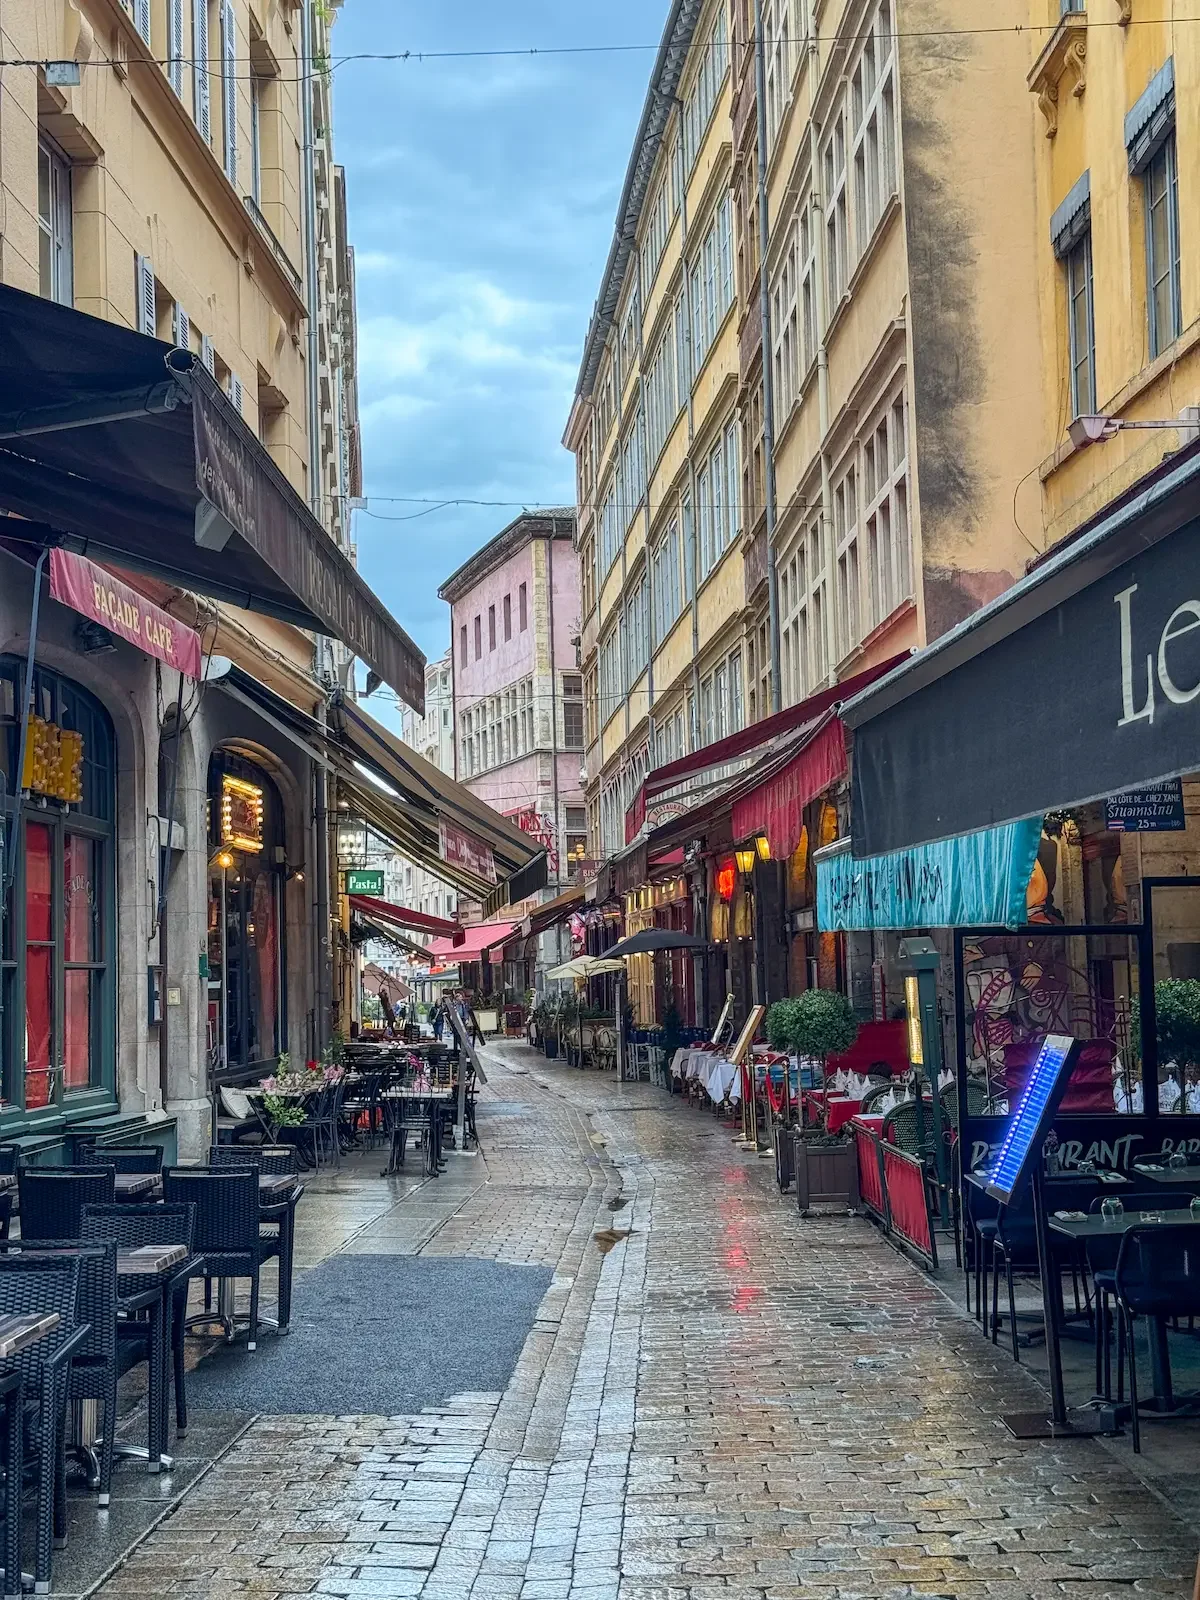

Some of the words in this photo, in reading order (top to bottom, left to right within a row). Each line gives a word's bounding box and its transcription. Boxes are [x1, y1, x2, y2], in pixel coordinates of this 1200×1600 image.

[93, 580, 140, 635] FAÇADE
[652, 803, 689, 816] RESTAURANT
[349, 876, 382, 890] Pasta!
